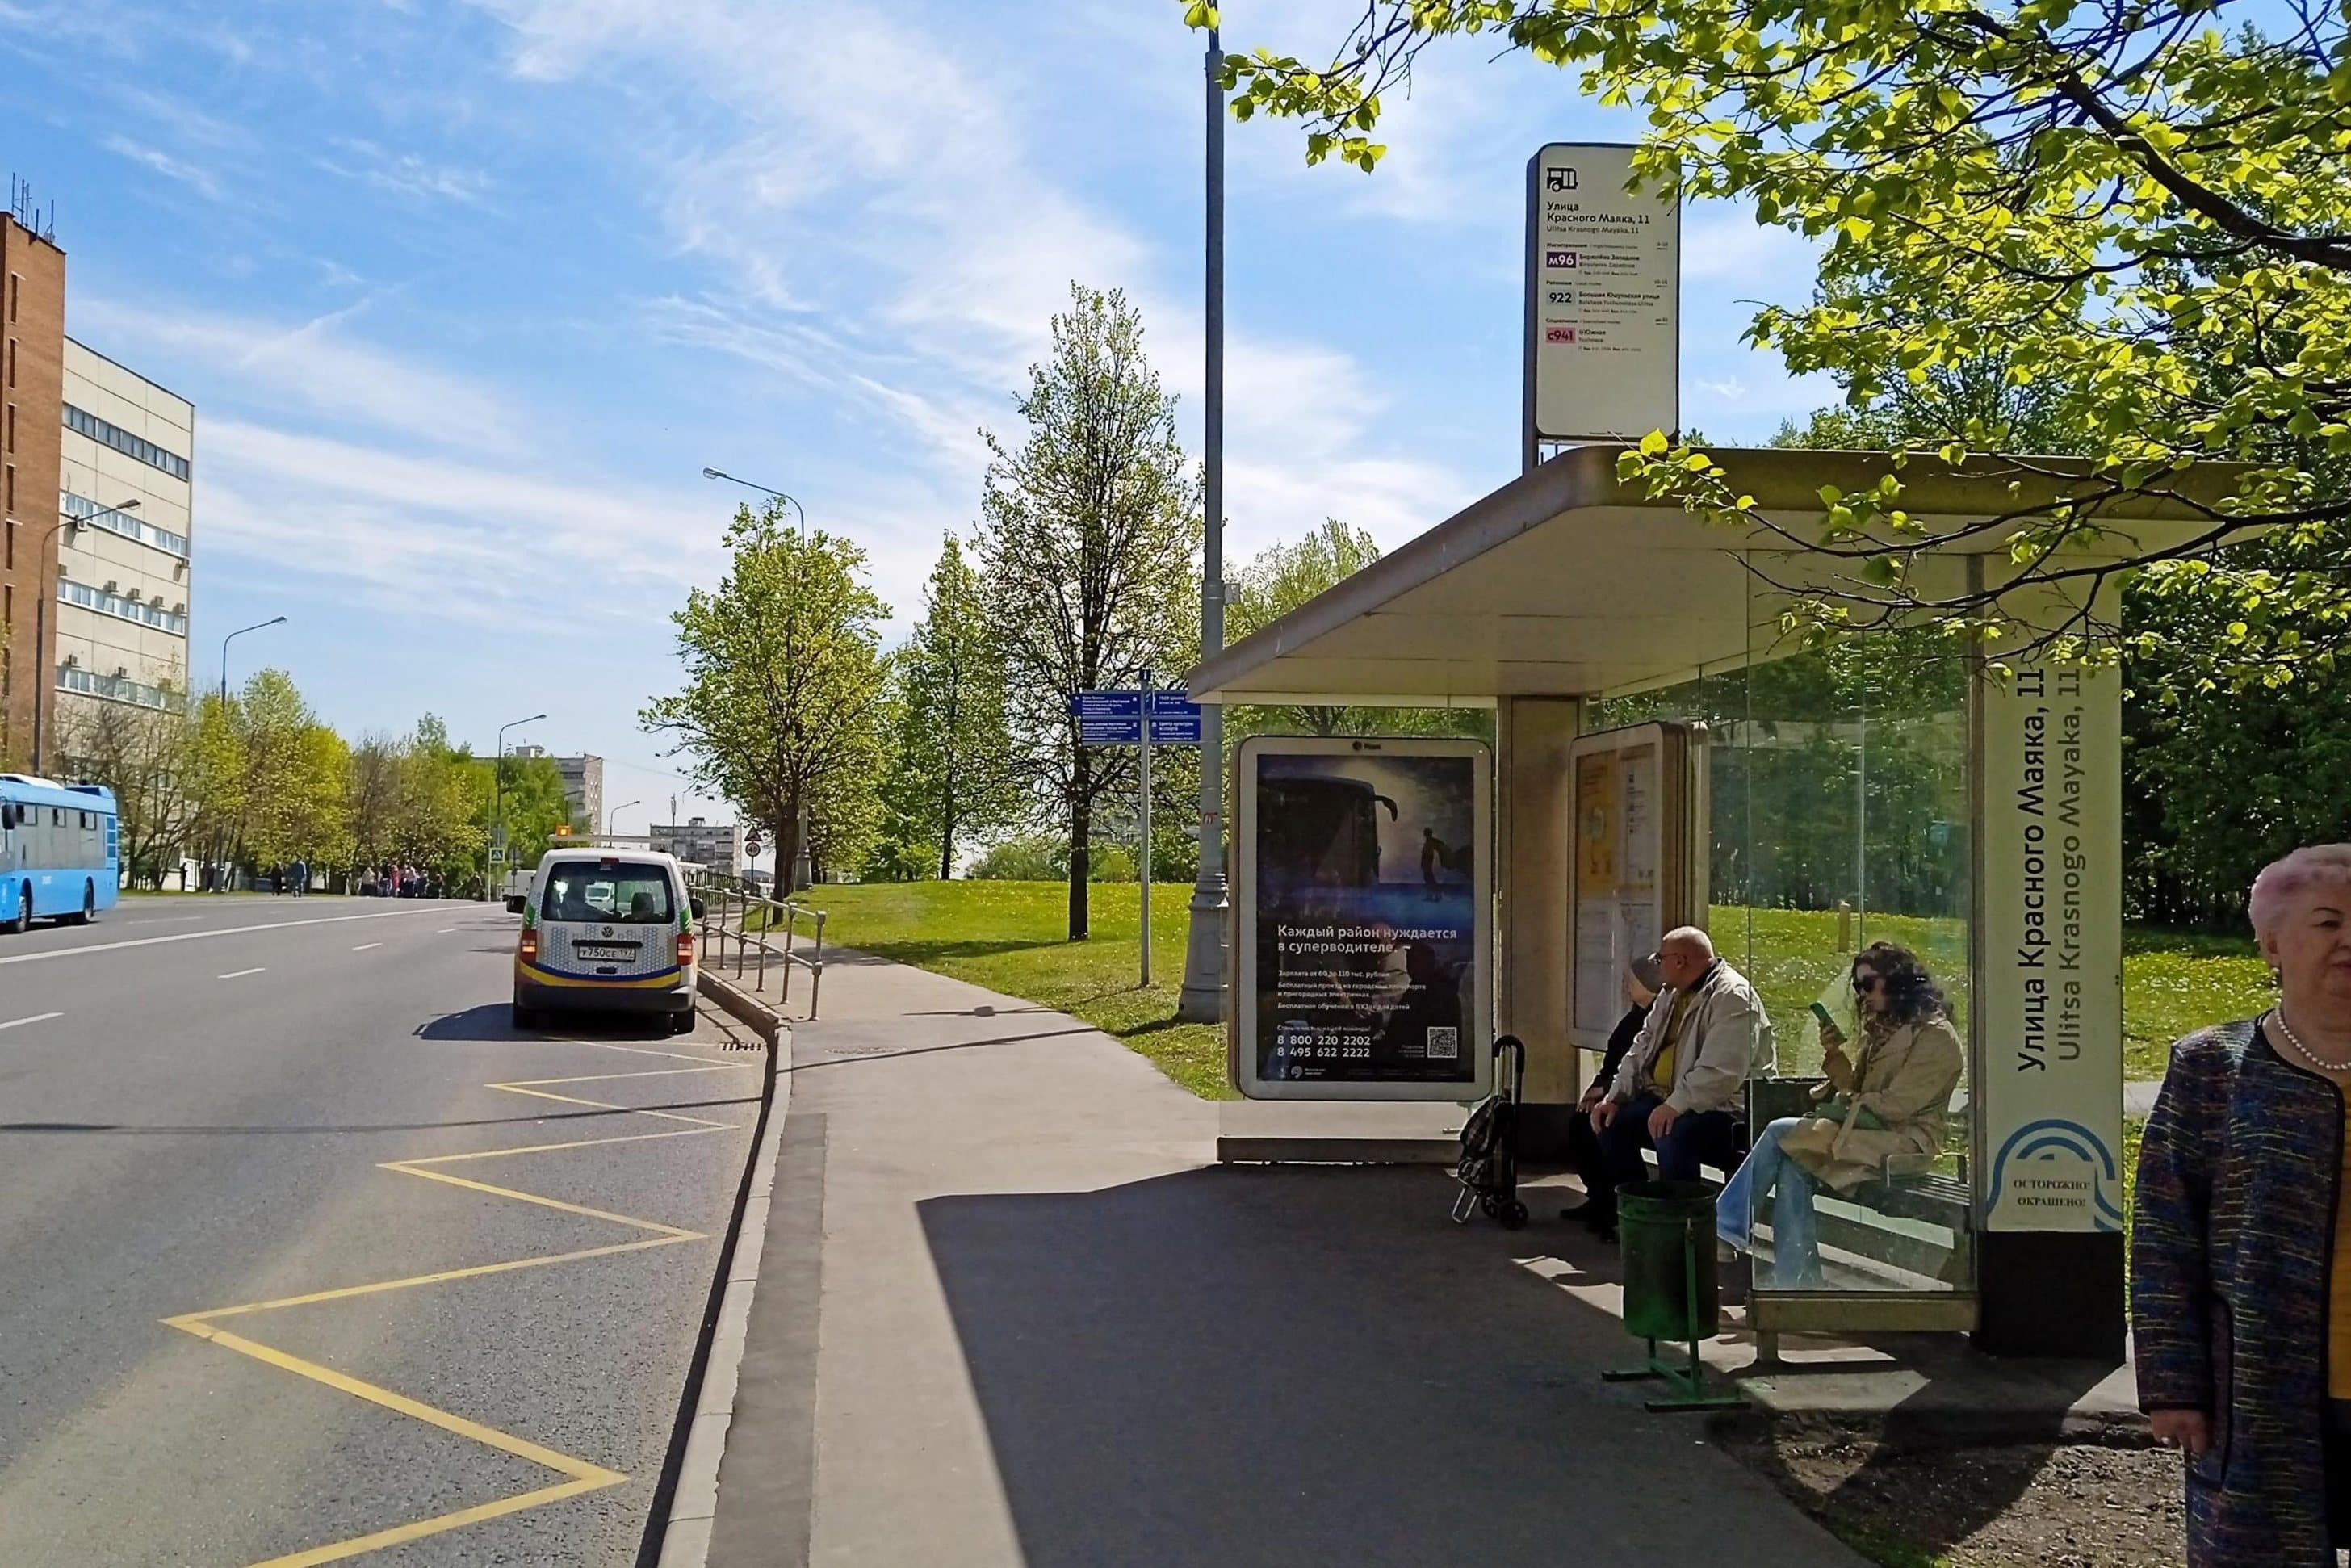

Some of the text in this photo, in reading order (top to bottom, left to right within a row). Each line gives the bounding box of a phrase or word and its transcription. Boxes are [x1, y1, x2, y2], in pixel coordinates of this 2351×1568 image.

[1547, 202, 1579, 211] Улица
[1547, 213, 1650, 224] Красного Маяка, 11
[1569, 226, 1600, 234] Krasnogo
[1602, 226, 1630, 234] Mayaka,
[1549, 292, 1573, 304] 922
[2018, 669, 2051, 1071] Улица Красного Маяка, 11
[2057, 669, 2086, 1060] Ulitsa Krasnogo Mayaka, 11
[1277, 925, 1457, 942] Каждый район нуждается
[1278, 943, 1398, 955] в суперводителе.
[1277, 1035, 1371, 1046] 8 800 220 2202
[1277, 1047, 1370, 1058] 8 495 622 2222
[2014, 1180, 2090, 1190] ОСТОРОЖНО!
[2017, 1197, 2086, 1207] ОКРАШЕНО!
